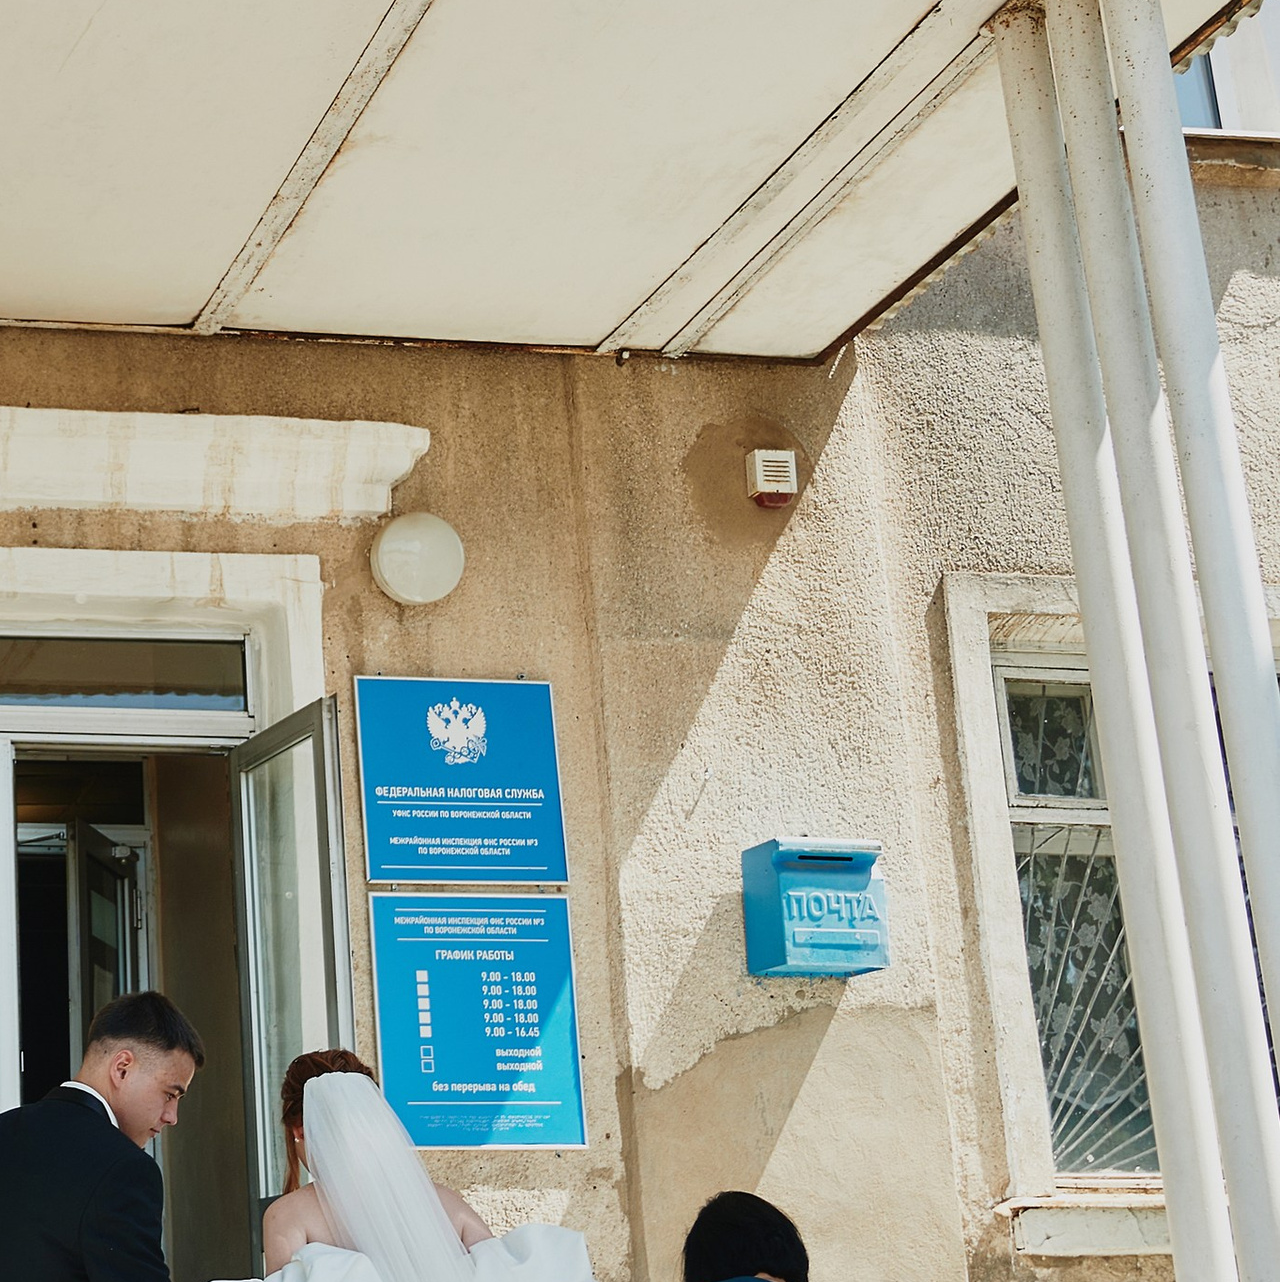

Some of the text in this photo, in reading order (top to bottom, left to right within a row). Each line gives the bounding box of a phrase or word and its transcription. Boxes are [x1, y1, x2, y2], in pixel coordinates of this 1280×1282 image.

[375, 786, 544, 799] ФЕДЕРАЛЬНАЯ НАЛОГОВАЯ СЛУЖБА
[392, 809, 531, 819] УФНС РОССИИ ПО ВОРОНЕЖСКОЙ ОБЛАСТИ
[389, 836, 440, 846] МЕЖРАЙОННАЯ
[442, 837, 482, 846] ИНСПЕКЦИЯ
[499, 838, 526, 846] РОССИИ
[429, 847, 479, 855] ВОРОНЕЖСКОЙ
[480, 848, 510, 856] ОБЛАСТИ
[786, 891, 880, 921] ПОЧТА
[394, 915, 447, 925] МЕЖРАЙОННАЯ
[448, 917, 489, 926] ИНСПЕКЦИЯ
[505, 918, 532, 926] РОССИИ
[424, 925, 517, 935] ПО ВОРОНЕЖСКОЙ ОБЛАСТИ
[435, 949, 514, 960] ГРАФИК РАБОТЫ
[481, 972, 501, 982] 9.00
[511, 972, 536, 982] 18.00
[482, 986, 502, 995] 9.00
[512, 986, 537, 995] 18.00
[483, 1000, 503, 1009] 9.00
[513, 1000, 538, 1009] 18.00
[484, 1013, 504, 1023] 9.00
[514, 1013, 539, 1023] 18.00
[485, 1027, 505, 1037] 9.00
[515, 1027, 540, 1037] 16.45
[496, 1047, 542, 1058] выходной
[497, 1060, 543, 1071] выходной
[432, 1081, 536, 1094] без перерыва на обед
